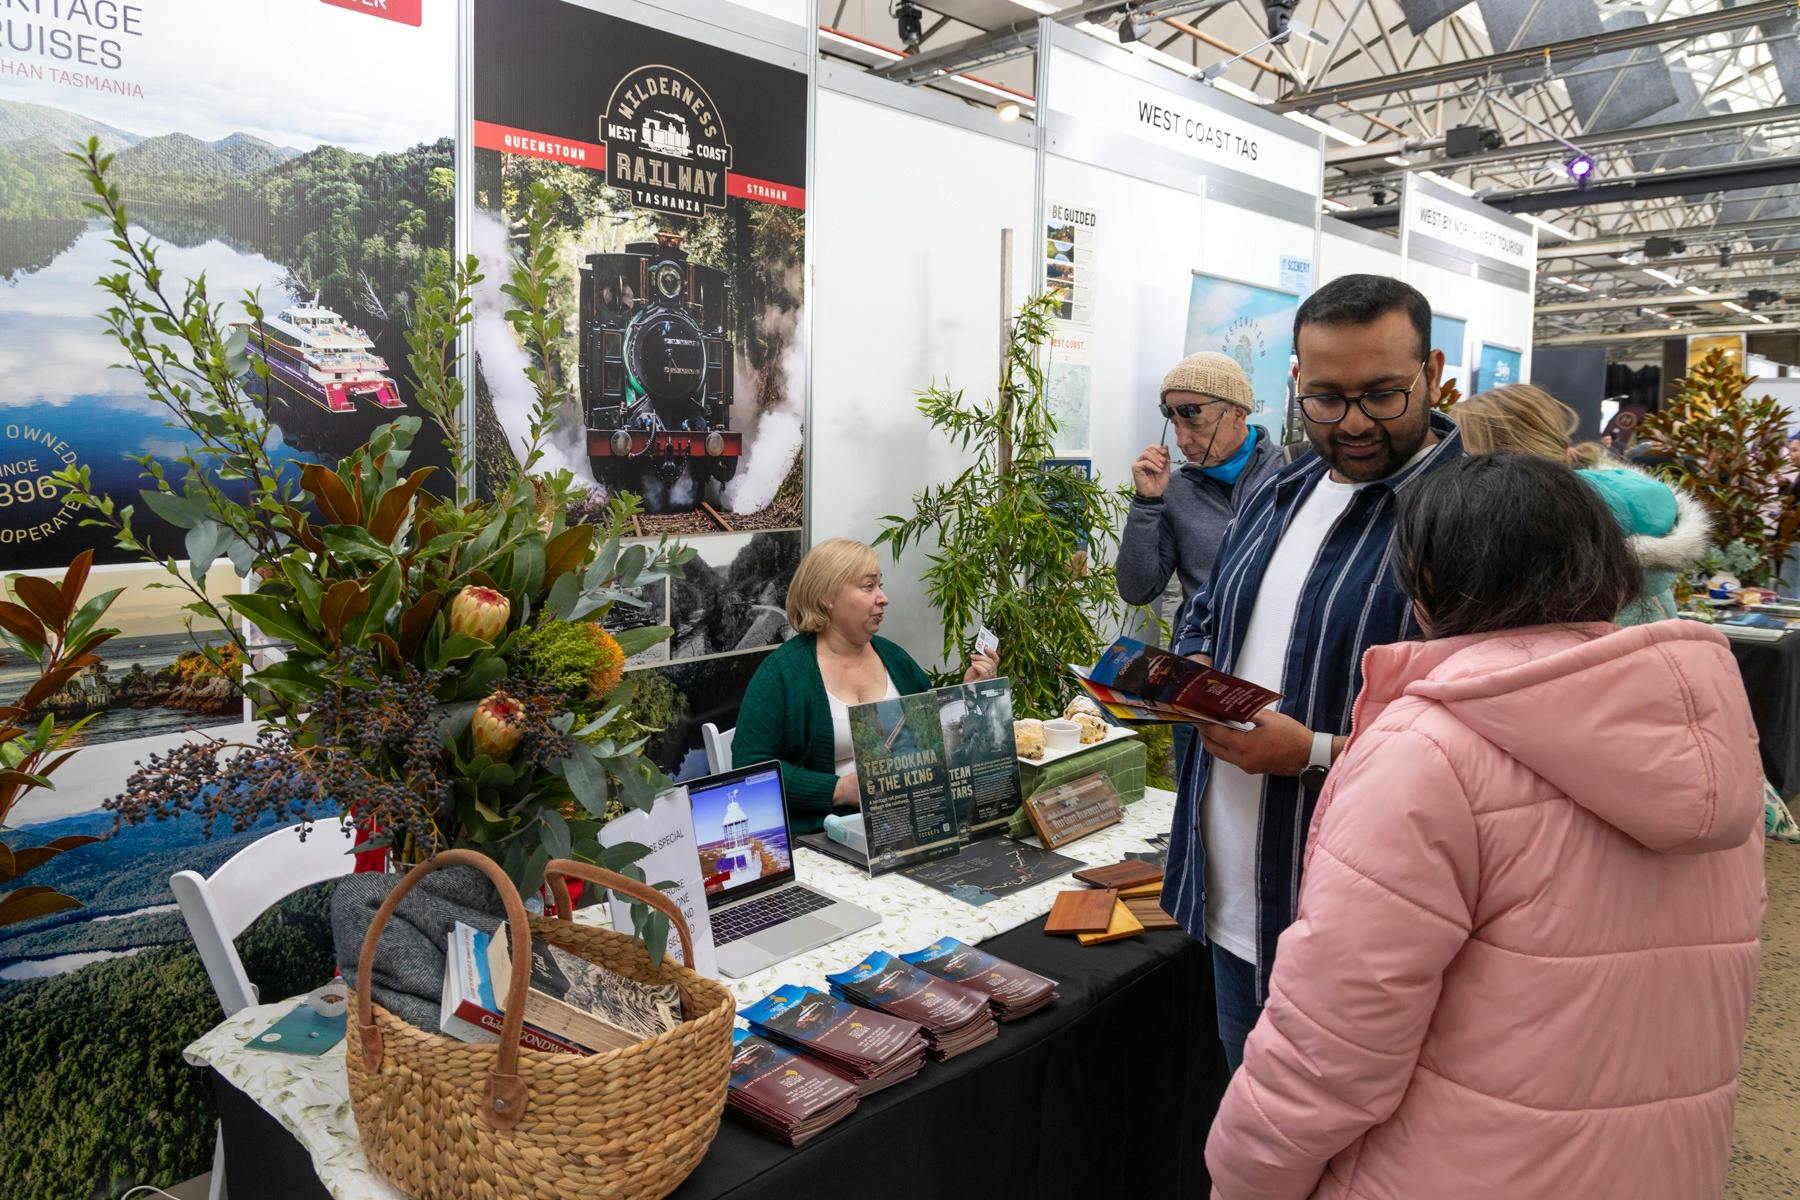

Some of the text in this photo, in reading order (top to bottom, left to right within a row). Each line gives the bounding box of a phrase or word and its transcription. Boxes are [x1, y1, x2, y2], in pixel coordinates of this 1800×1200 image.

[0, 19, 122, 70] UISES
[48, 67, 144, 99] TASMANIA
[618, 76, 717, 138] WILDERNESS
[608, 123, 727, 162] WEST COAST
[1138, 100, 1258, 161] WEST COAST TAS
[504, 134, 586, 161] QUEENSTOWN
[616, 152, 718, 197] RAILWAY
[636, 190, 700, 213] TASMANIA
[746, 183, 787, 201] STRAHAN
[1052, 204, 1063, 220] BE
[1064, 207, 1096, 227] GUIDED
[6, 424, 78, 464] OWNED
[0, 459, 40, 478] INCE
[0, 475, 58, 507] 896
[0, 489, 82, 544] OPERATE
[863, 749, 938, 777] TEEPOOKANA
[949, 765, 971, 780] TEAM
[866, 768, 934, 795] & THE KING
[950, 784, 973, 800] TARS
[658, 828, 684, 850] SPECIAL
